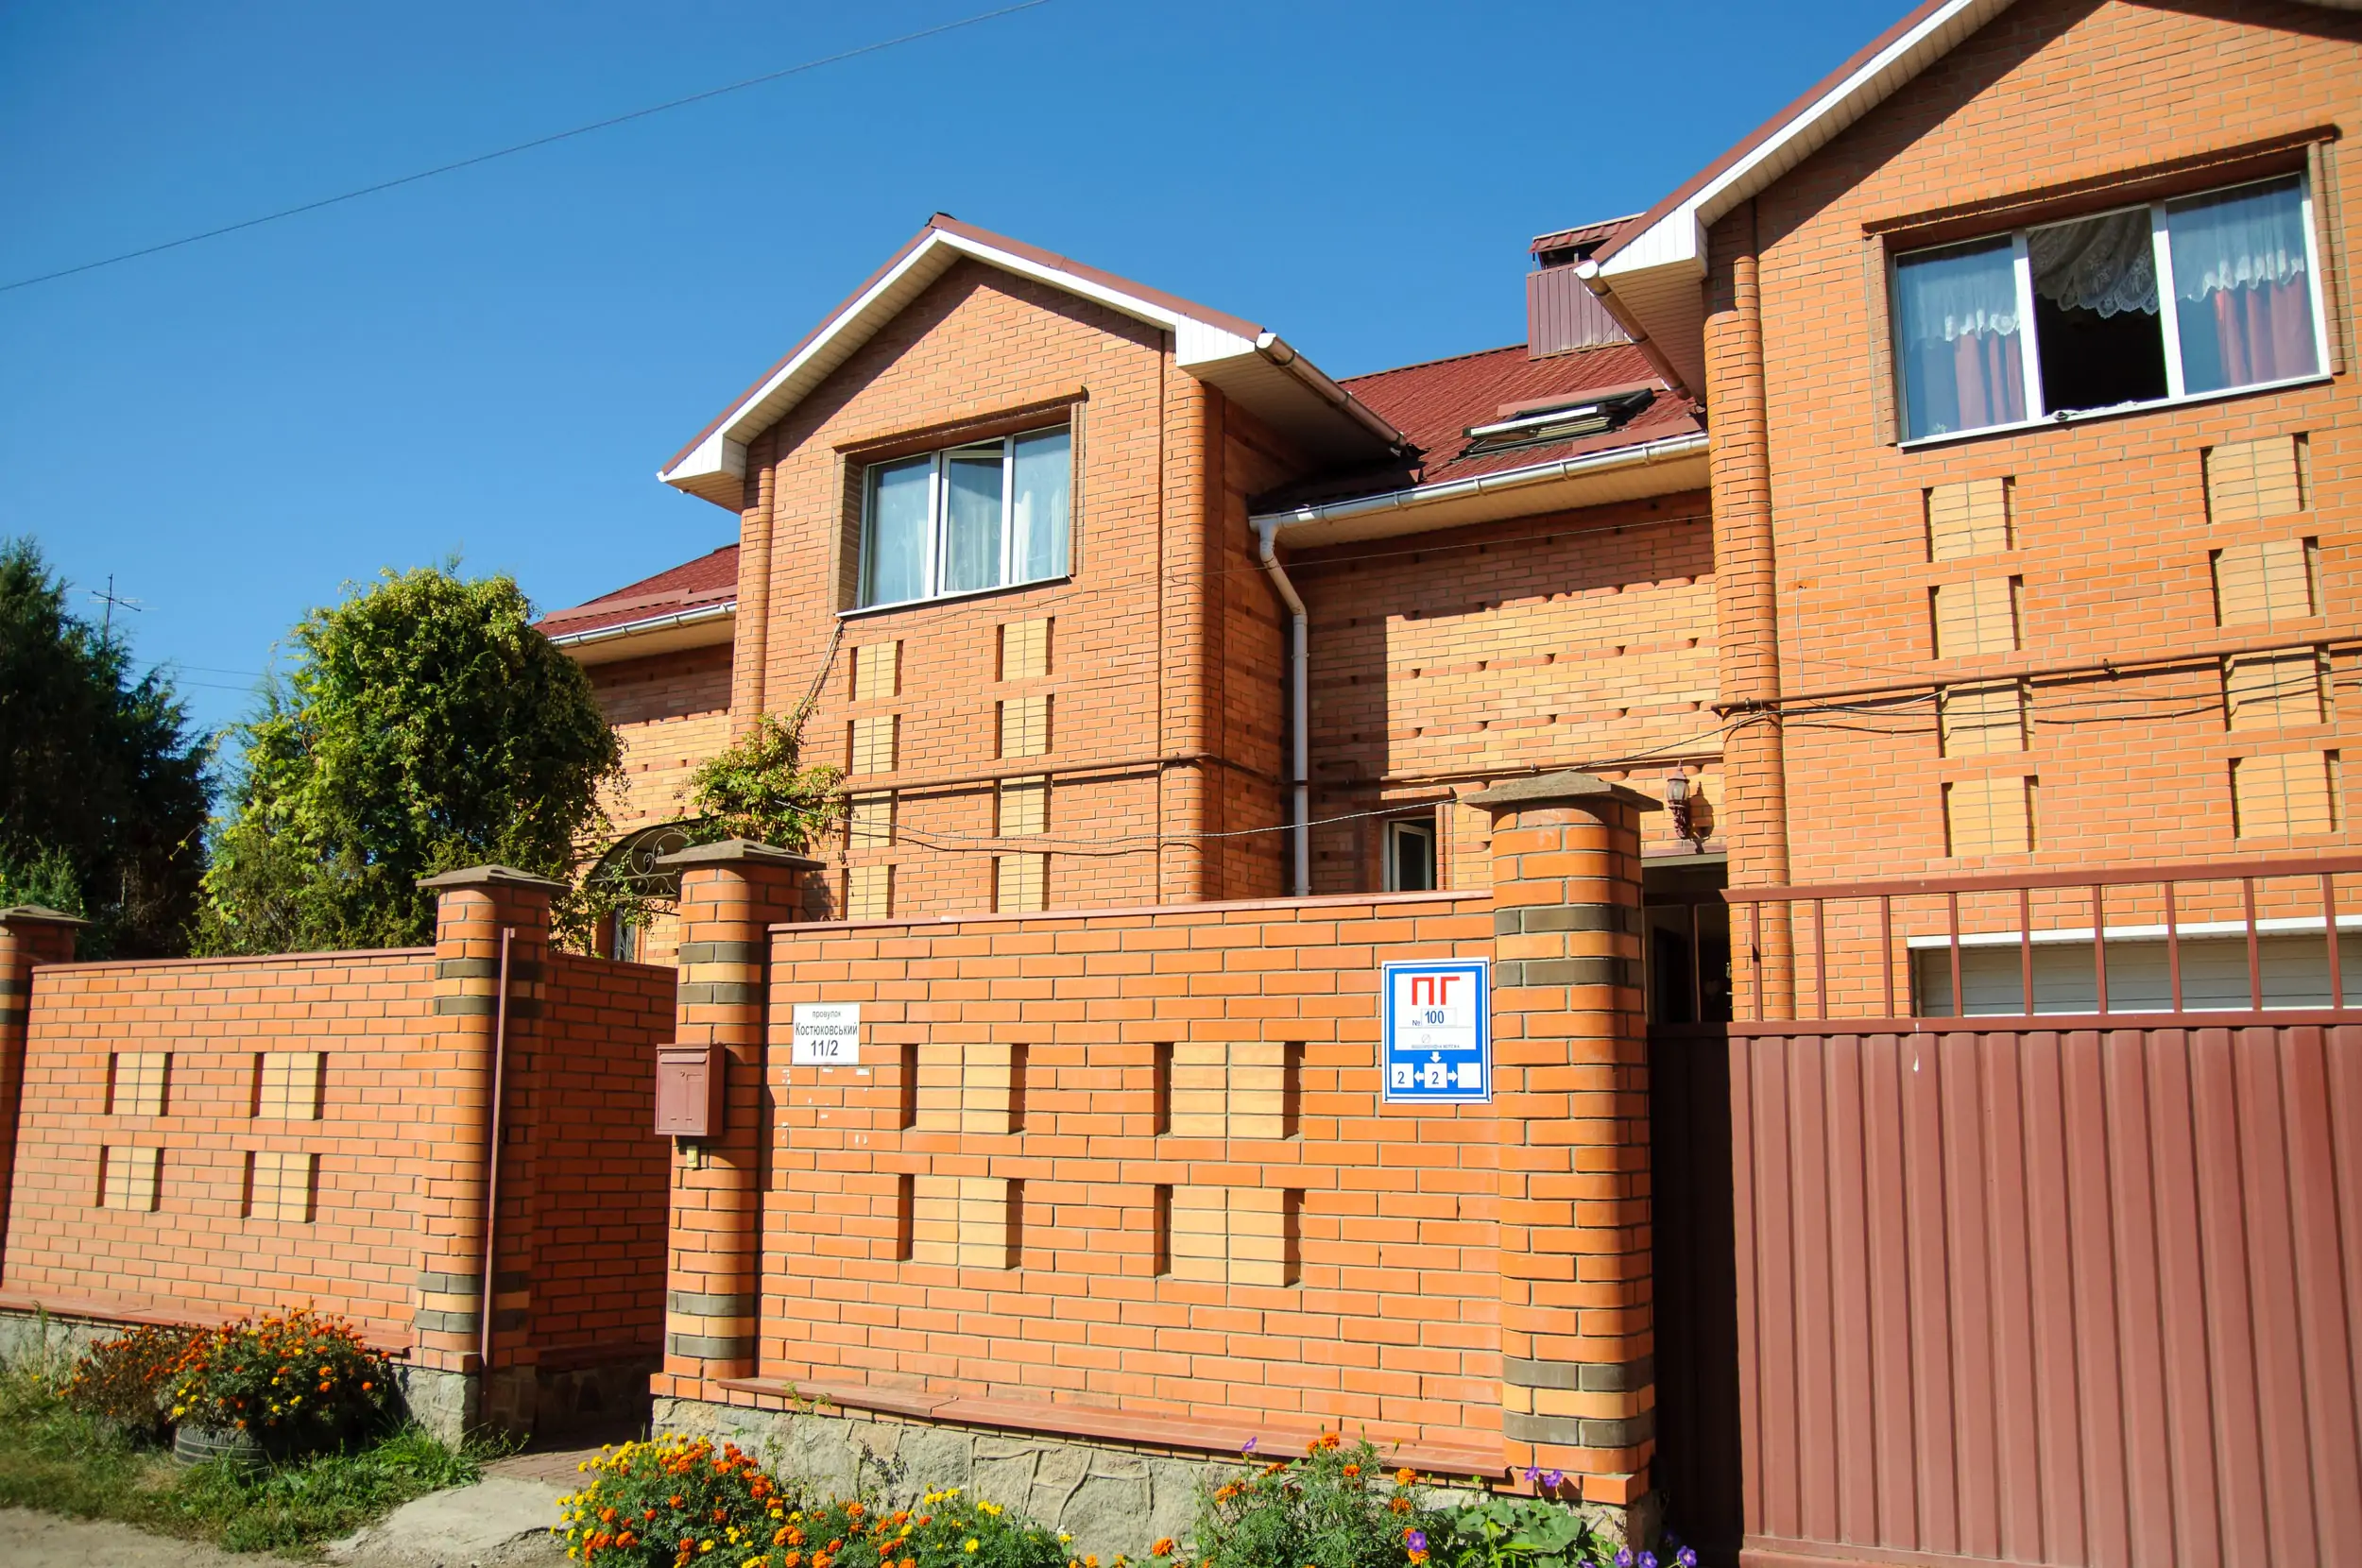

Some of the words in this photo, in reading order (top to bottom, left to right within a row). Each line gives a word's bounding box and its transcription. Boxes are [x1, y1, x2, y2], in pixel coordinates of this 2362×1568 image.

[1412, 976, 1461, 1006] ПГ
[812, 1010, 842, 1020] провулок
[1425, 1010, 1445, 1025] 100
[795, 1021, 858, 1036] Костюковський
[810, 1039, 839, 1057] 11/2
[1397, 1070, 1406, 1085] 2
[1431, 1070, 1440, 1085] 2
